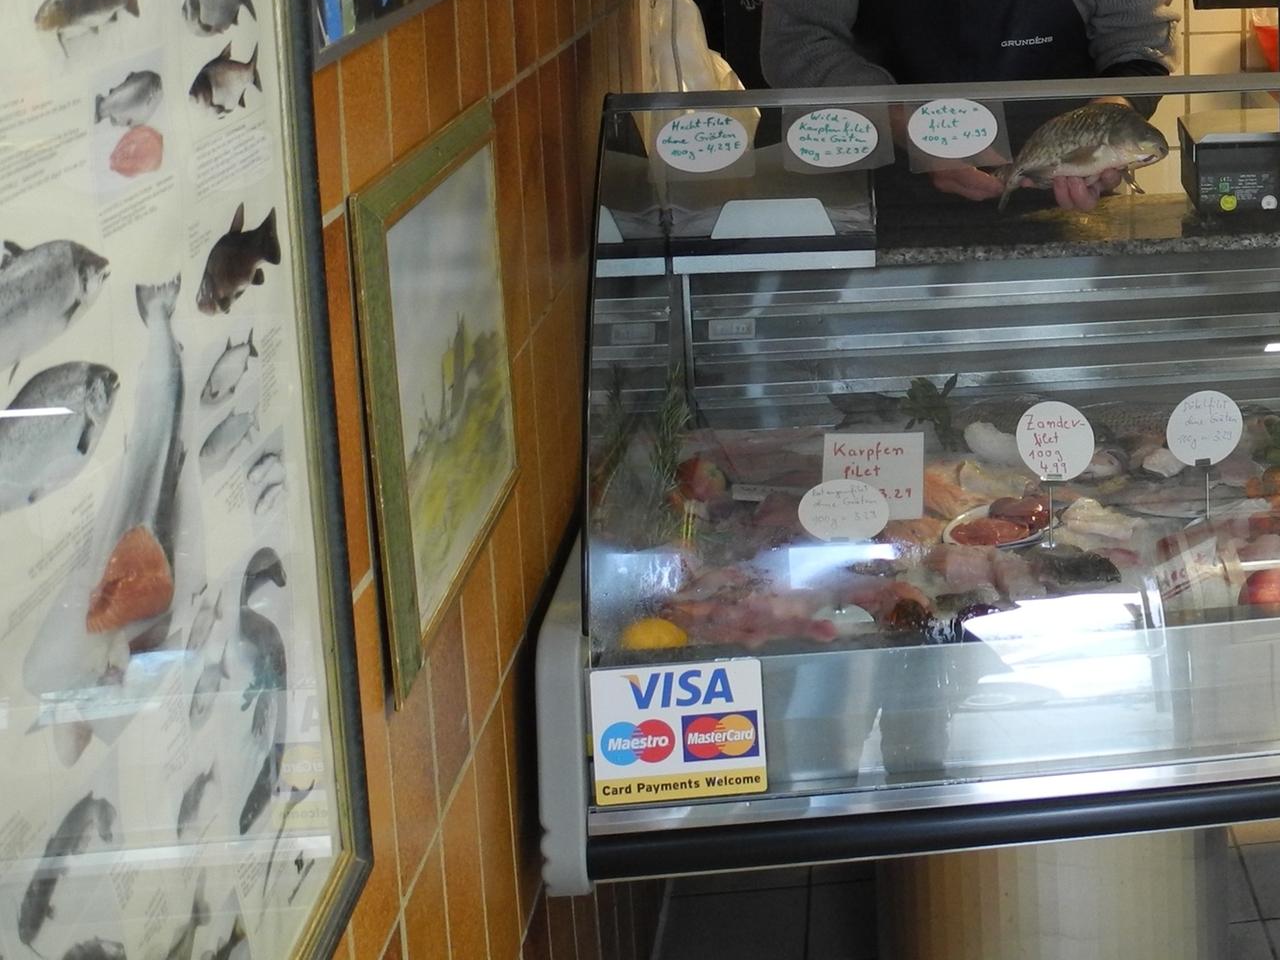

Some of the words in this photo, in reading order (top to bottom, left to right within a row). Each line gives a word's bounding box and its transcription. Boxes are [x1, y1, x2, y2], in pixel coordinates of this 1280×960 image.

[832, 441, 904, 461] Karpfen
[620, 667, 735, 710] VISA
[607, 734, 670, 752] Maestro
[687, 727, 755, 745] MasterCard
[602, 784, 632, 797] Card
[636, 777, 701, 795] Payments
[705, 773, 762, 788] Welcome
